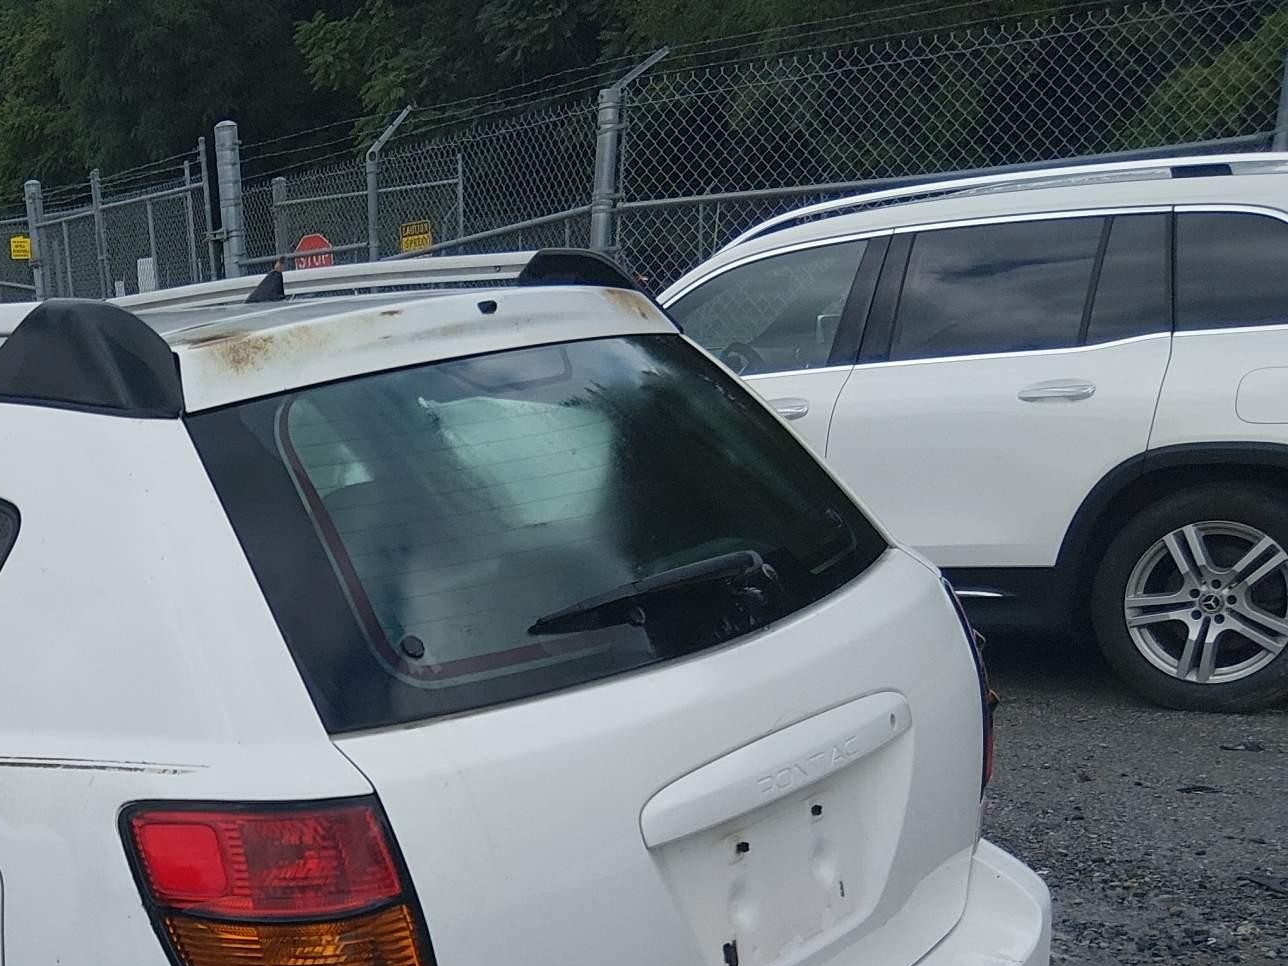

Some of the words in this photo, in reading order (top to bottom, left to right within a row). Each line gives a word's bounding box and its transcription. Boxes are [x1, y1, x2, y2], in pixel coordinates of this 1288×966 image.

[402, 223, 429, 236] CAUTION
[298, 254, 329, 269] STOP
[756, 735, 858, 796] PONTAC
